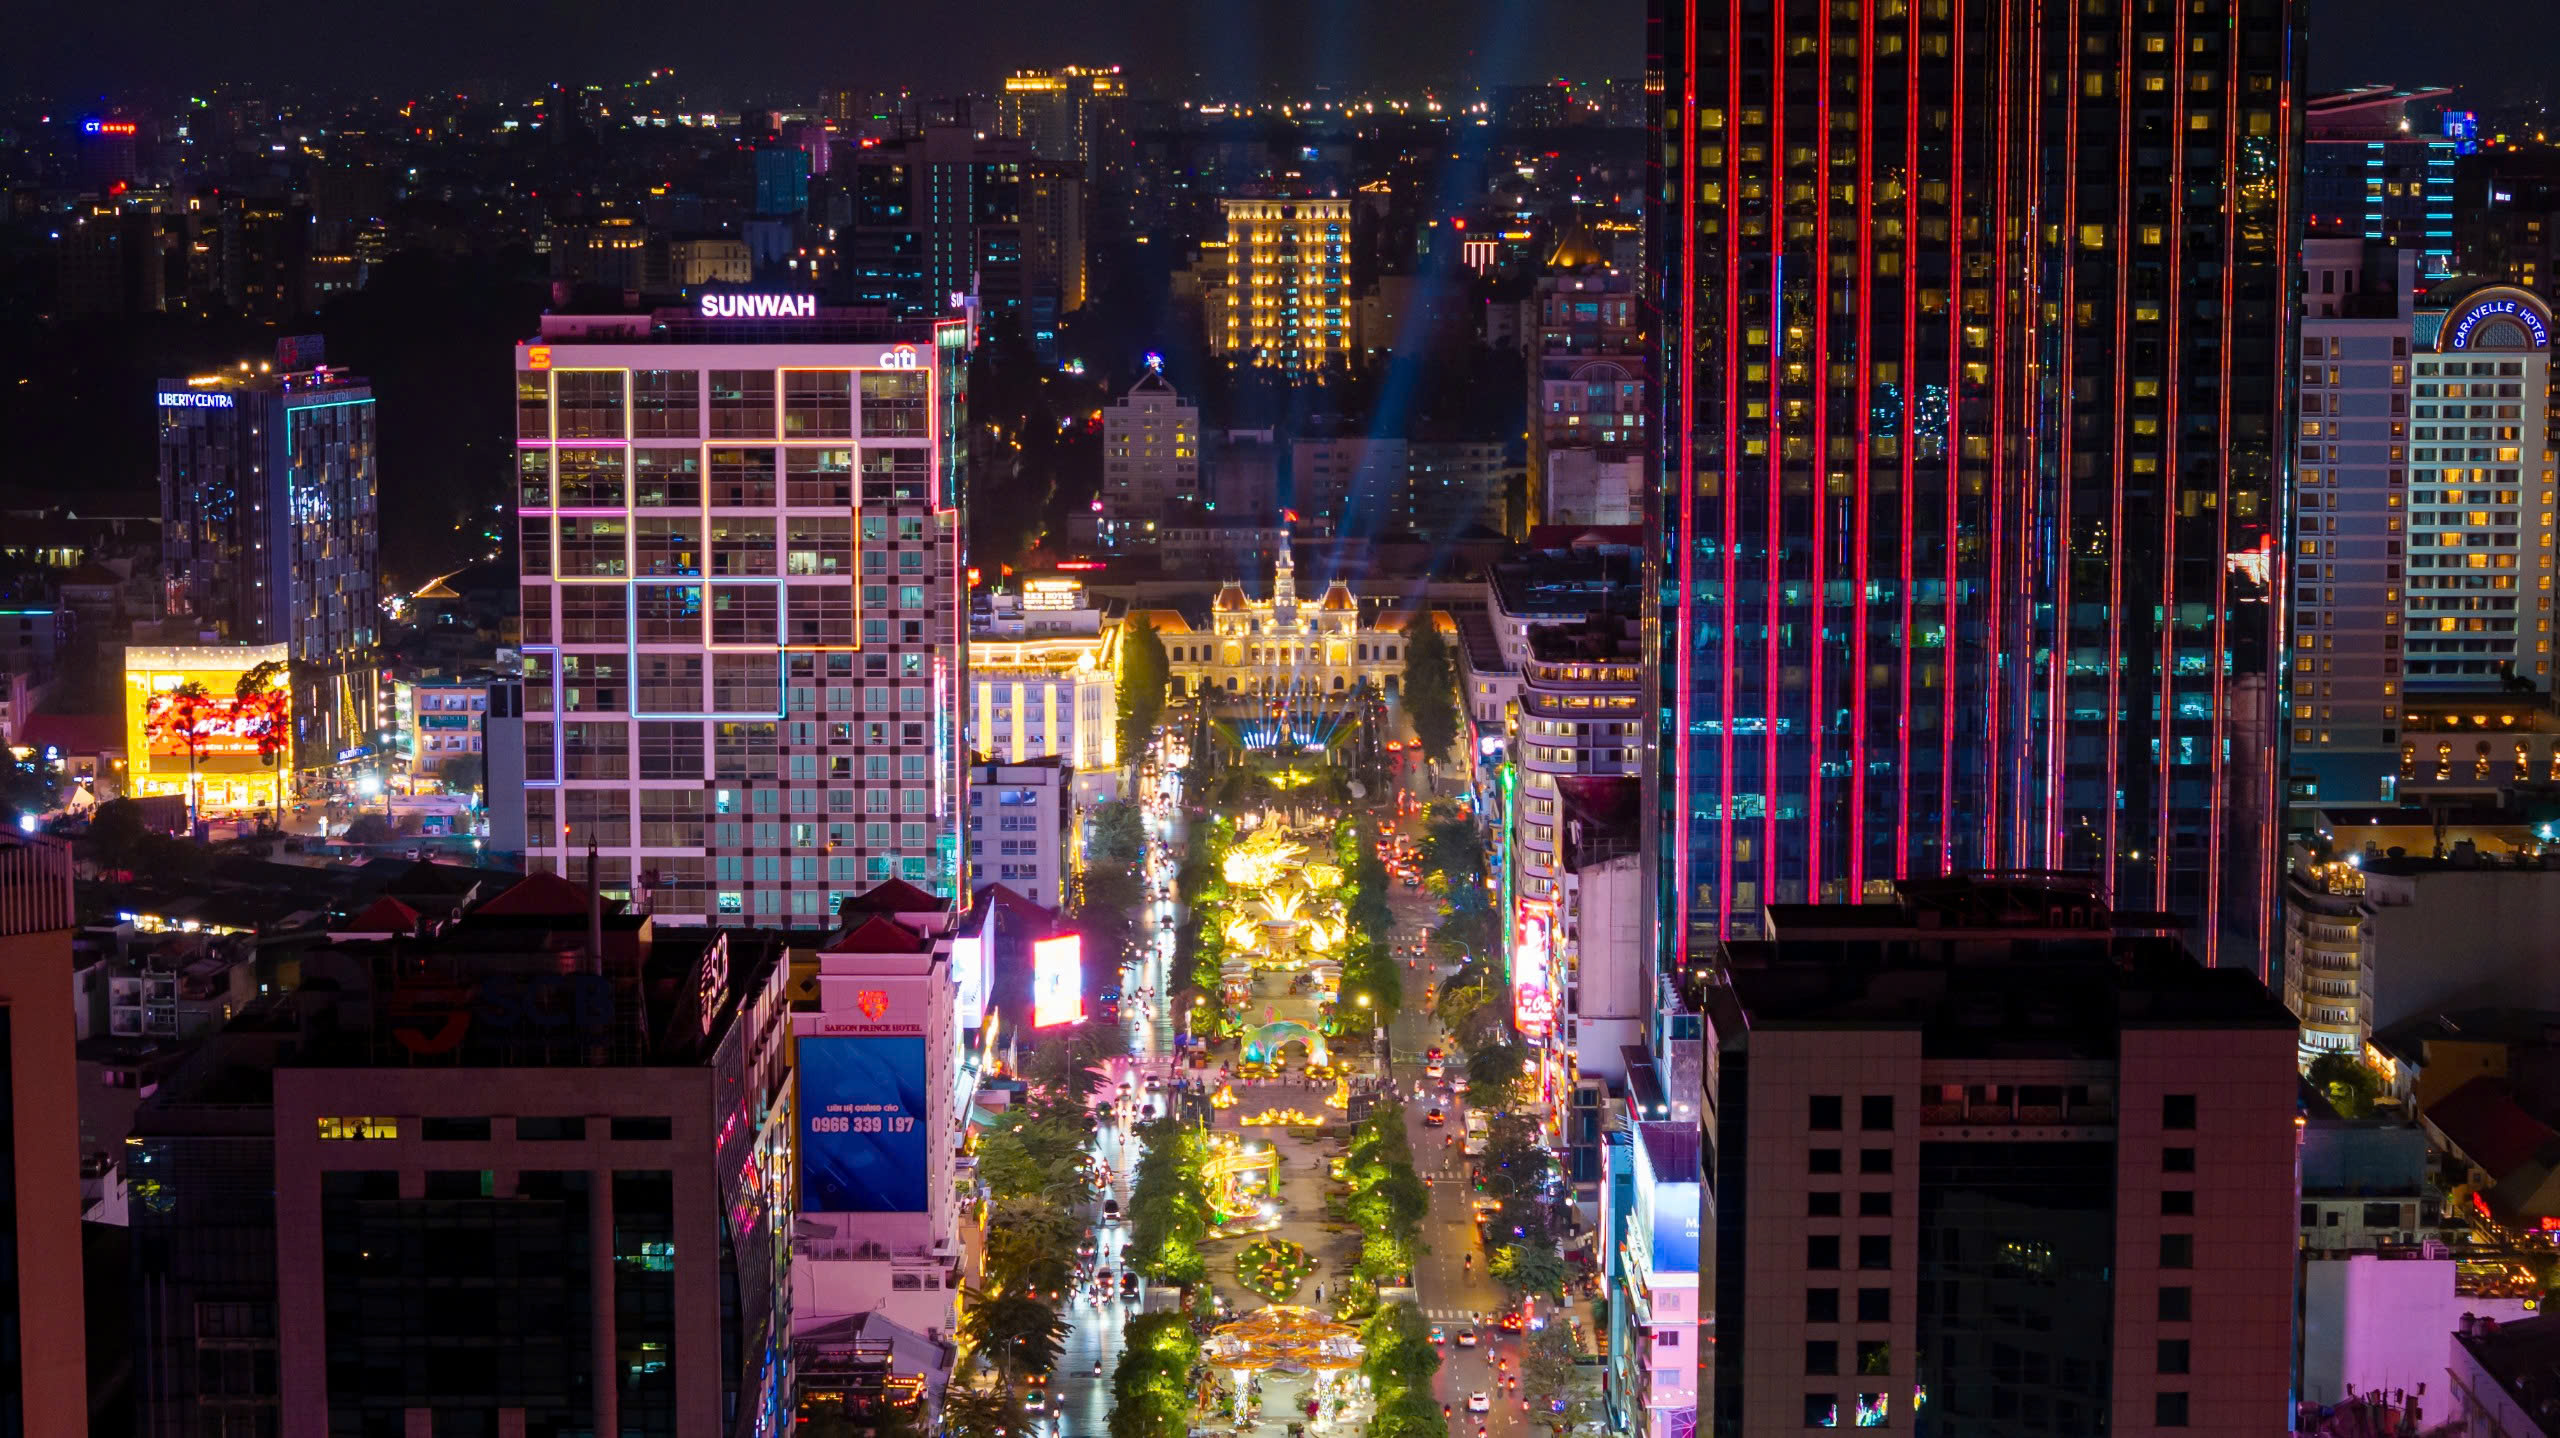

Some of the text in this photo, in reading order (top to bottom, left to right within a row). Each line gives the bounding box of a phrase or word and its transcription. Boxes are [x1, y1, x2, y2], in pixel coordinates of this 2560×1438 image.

[86, 122, 99, 131] CT
[701, 295, 815, 317] SUNWAH
[2454, 302, 2546, 347] CARAVELLE HOTEL
[880, 349, 916, 369] citi
[158, 392, 195, 406] LIBERTY
[824, 1024, 922, 1032] SAIGON PRINCE HOTEL
[811, 1116, 914, 1133] 0966 339 197
[1685, 1217, 1699, 1229] M
